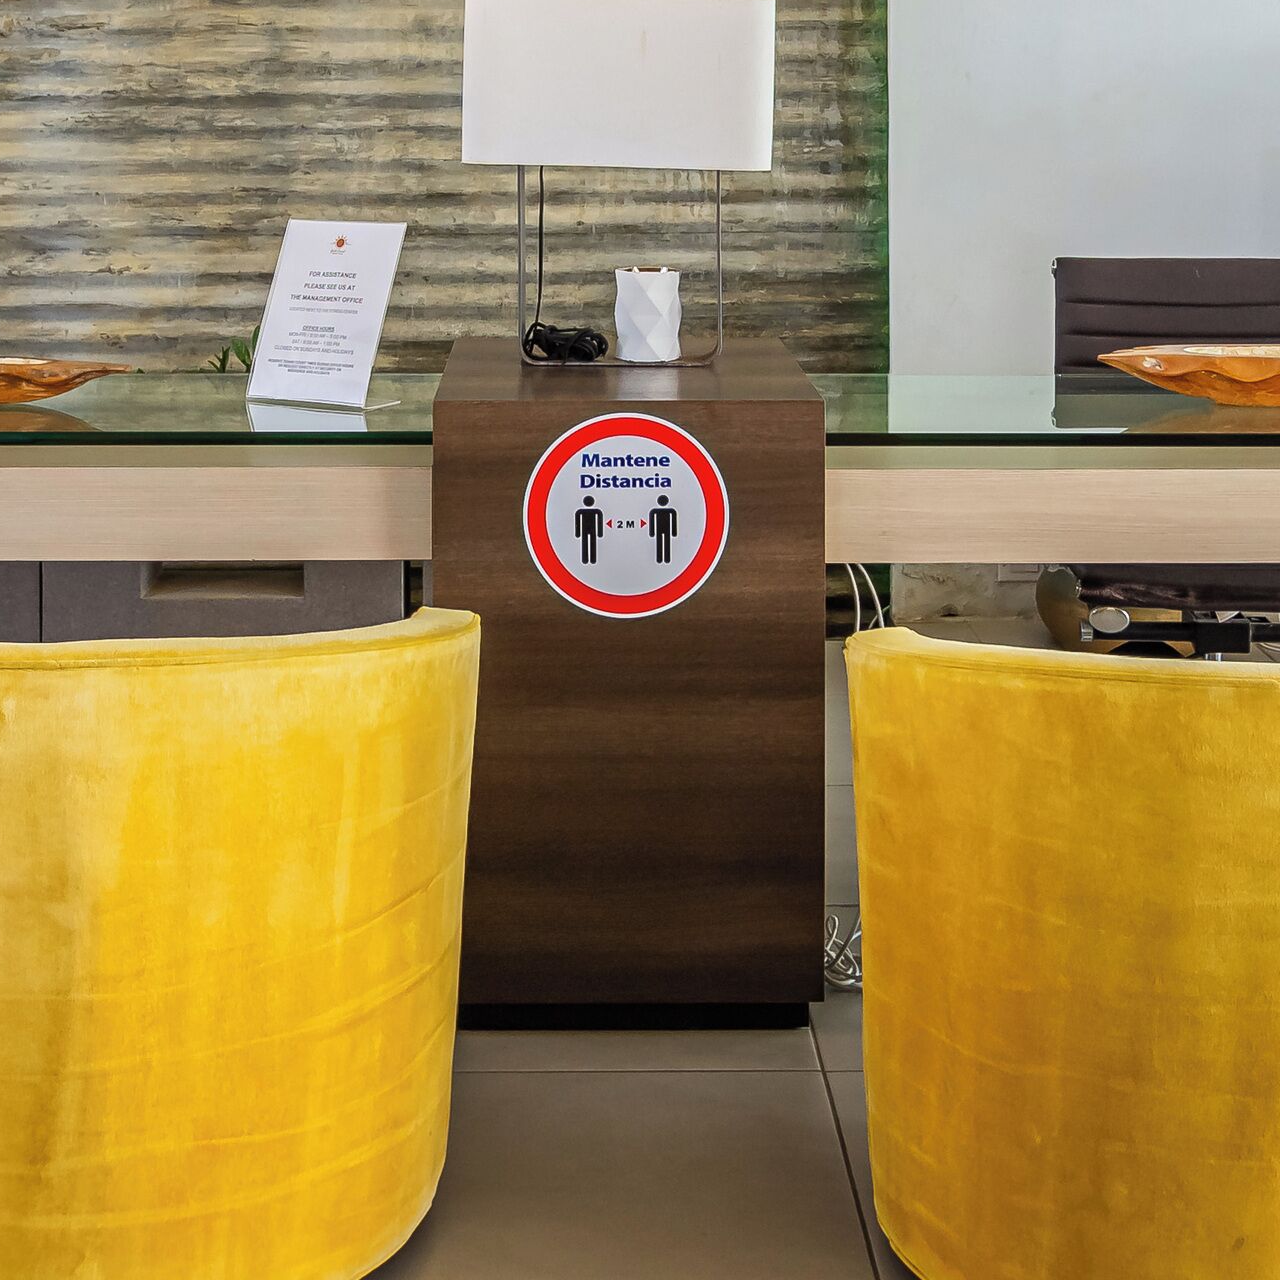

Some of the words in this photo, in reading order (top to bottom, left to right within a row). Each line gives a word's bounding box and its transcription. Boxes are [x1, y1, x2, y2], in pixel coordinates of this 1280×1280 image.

[322, 271, 357, 279] ASSISTANCE
[304, 282, 326, 290] PLEASE
[302, 294, 341, 302] MANAGEMENT
[342, 296, 363, 304] OFFICE
[581, 453, 670, 468] Mantene
[580, 473, 672, 488] Distancia
[616, 520, 623, 528] 2
[626, 520, 635, 528] M
